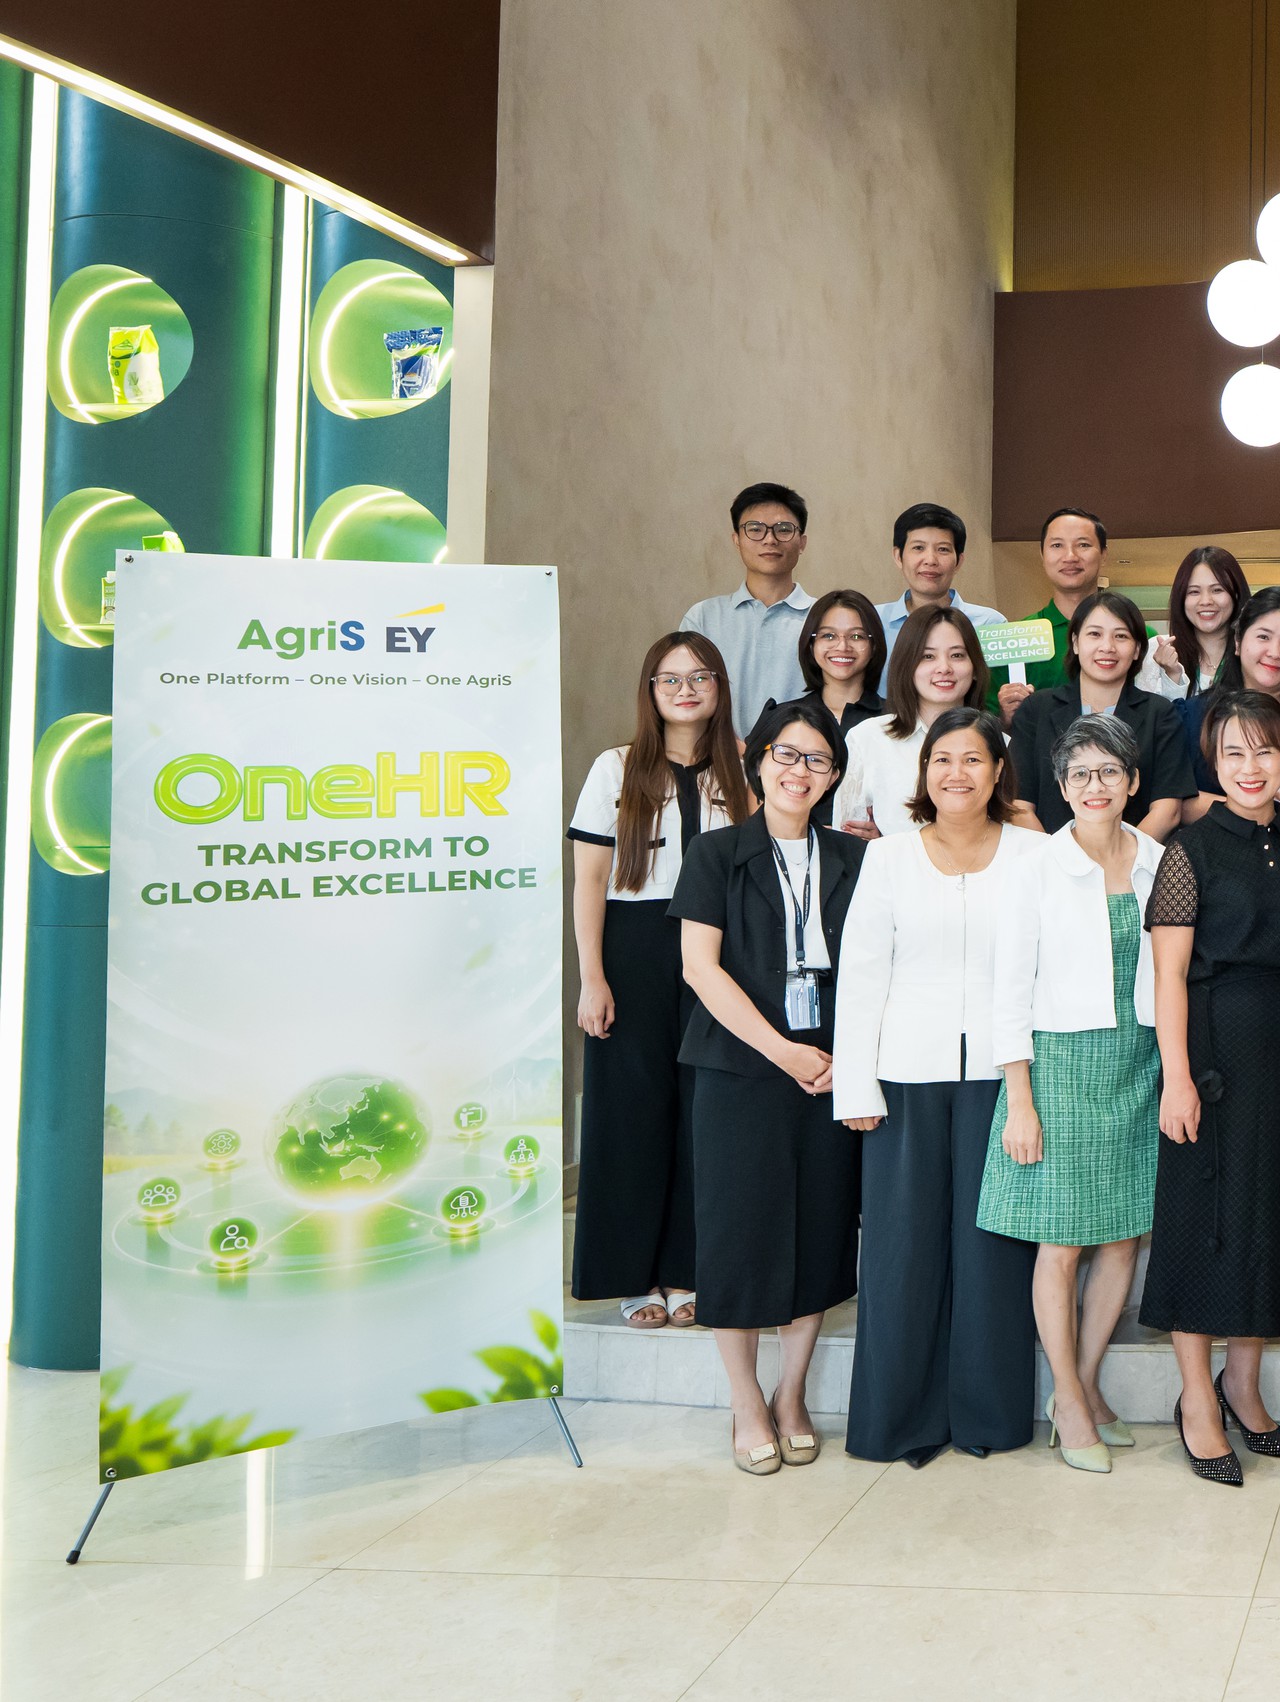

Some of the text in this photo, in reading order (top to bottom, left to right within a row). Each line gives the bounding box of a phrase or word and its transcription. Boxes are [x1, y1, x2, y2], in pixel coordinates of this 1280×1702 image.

[237, 619, 365, 660] AgriS
[385, 626, 435, 653] EY
[979, 625, 1043, 638] Transform
[987, 635, 1049, 651] GLOBAL
[159, 672, 200, 685] One
[207, 672, 290, 685] Platform
[309, 673, 347, 685] One
[353, 673, 407, 685] Vision
[426, 674, 461, 686] One
[466, 674, 512, 688] AgriS
[153, 750, 511, 825] OneHR
[198, 835, 490, 867] TRANSFORM TO
[141, 867, 537, 906] GLOBAL EXCELLENCE
